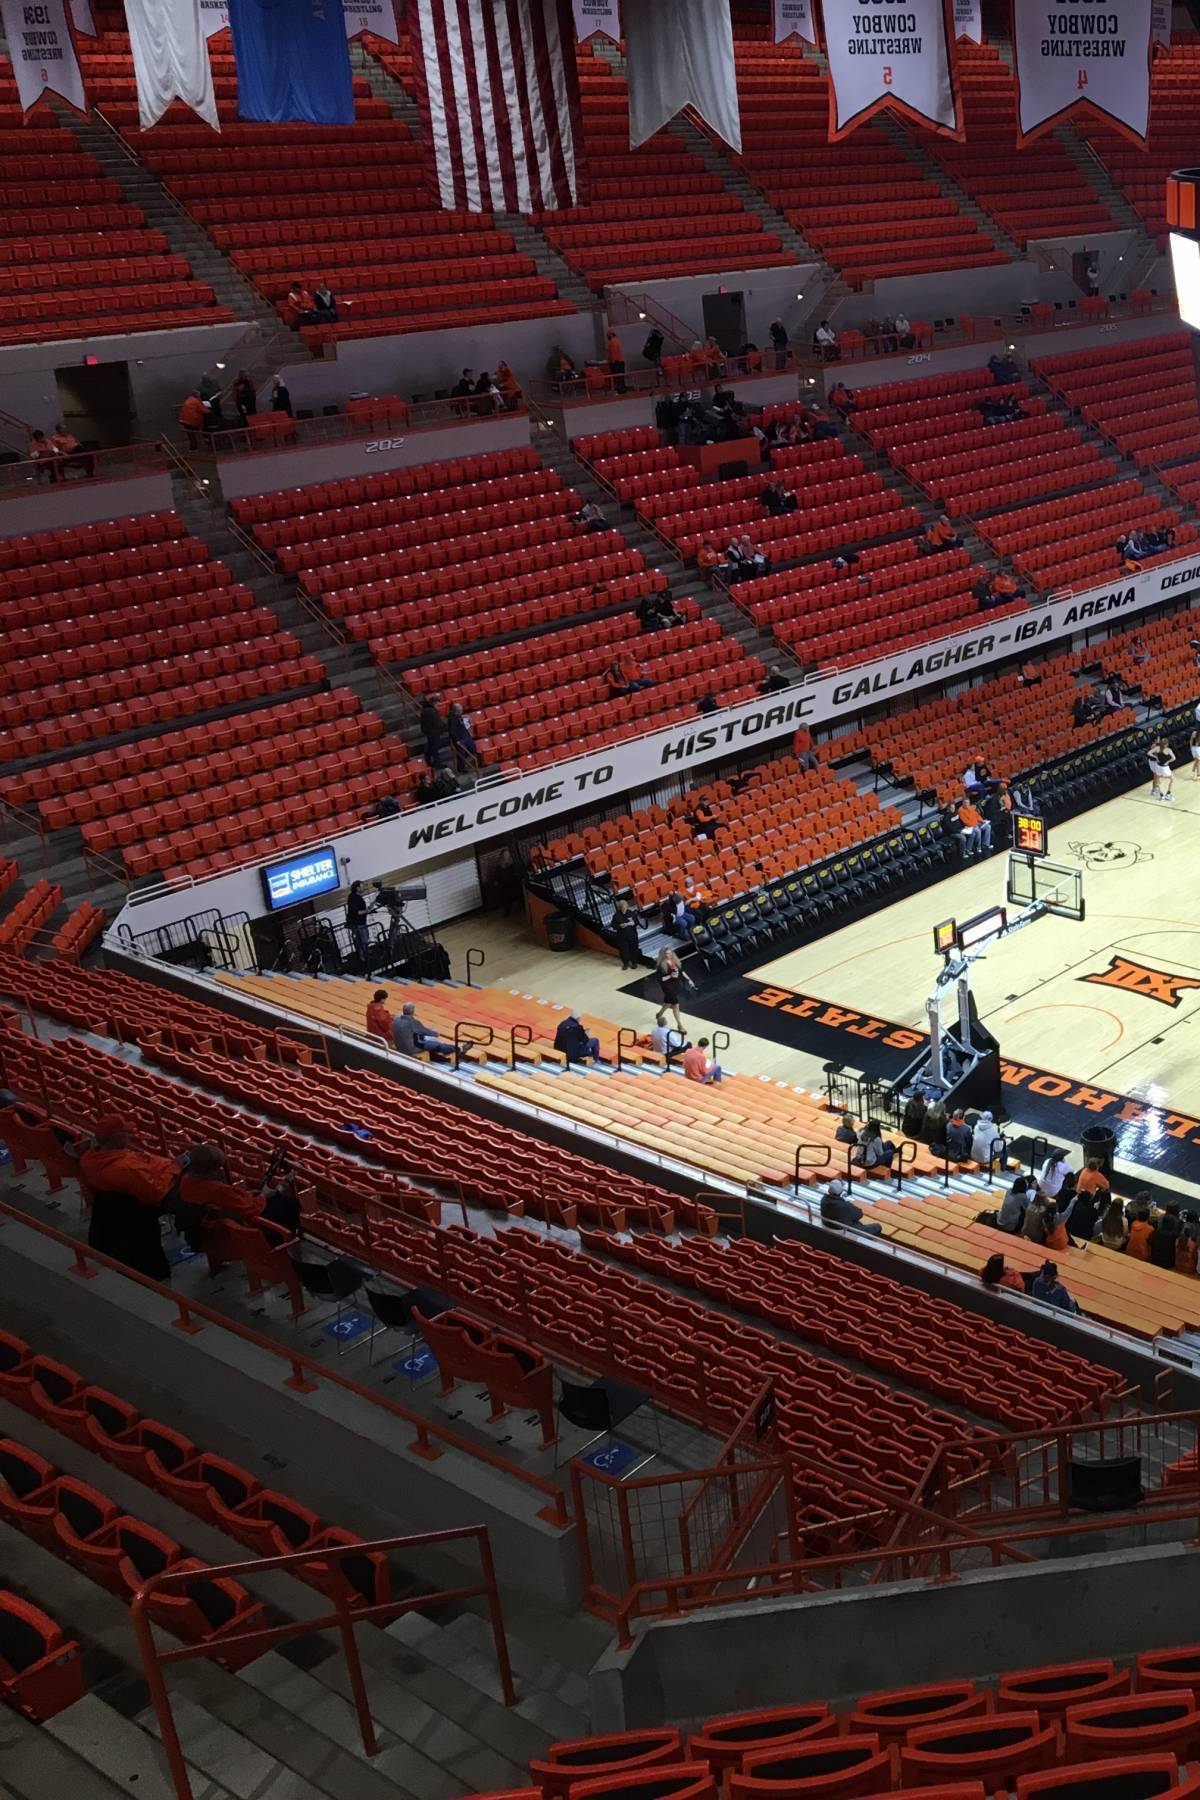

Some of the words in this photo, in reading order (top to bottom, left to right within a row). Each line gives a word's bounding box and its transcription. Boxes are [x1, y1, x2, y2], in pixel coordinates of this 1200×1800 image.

[907, 353, 931, 365] 204
[673, 390, 702, 403] 23
[365, 437, 405, 453] 202
[661, 695, 817, 764] HISTORIC
[1063, 587, 1136, 626] ARENA
[408, 781, 565, 849] WELCOME
[575, 765, 614, 791] TO
[290, 858, 334, 880] SHELTER
[292, 869, 336, 890] INSURANCE
[747, 986, 925, 1050] STATE
